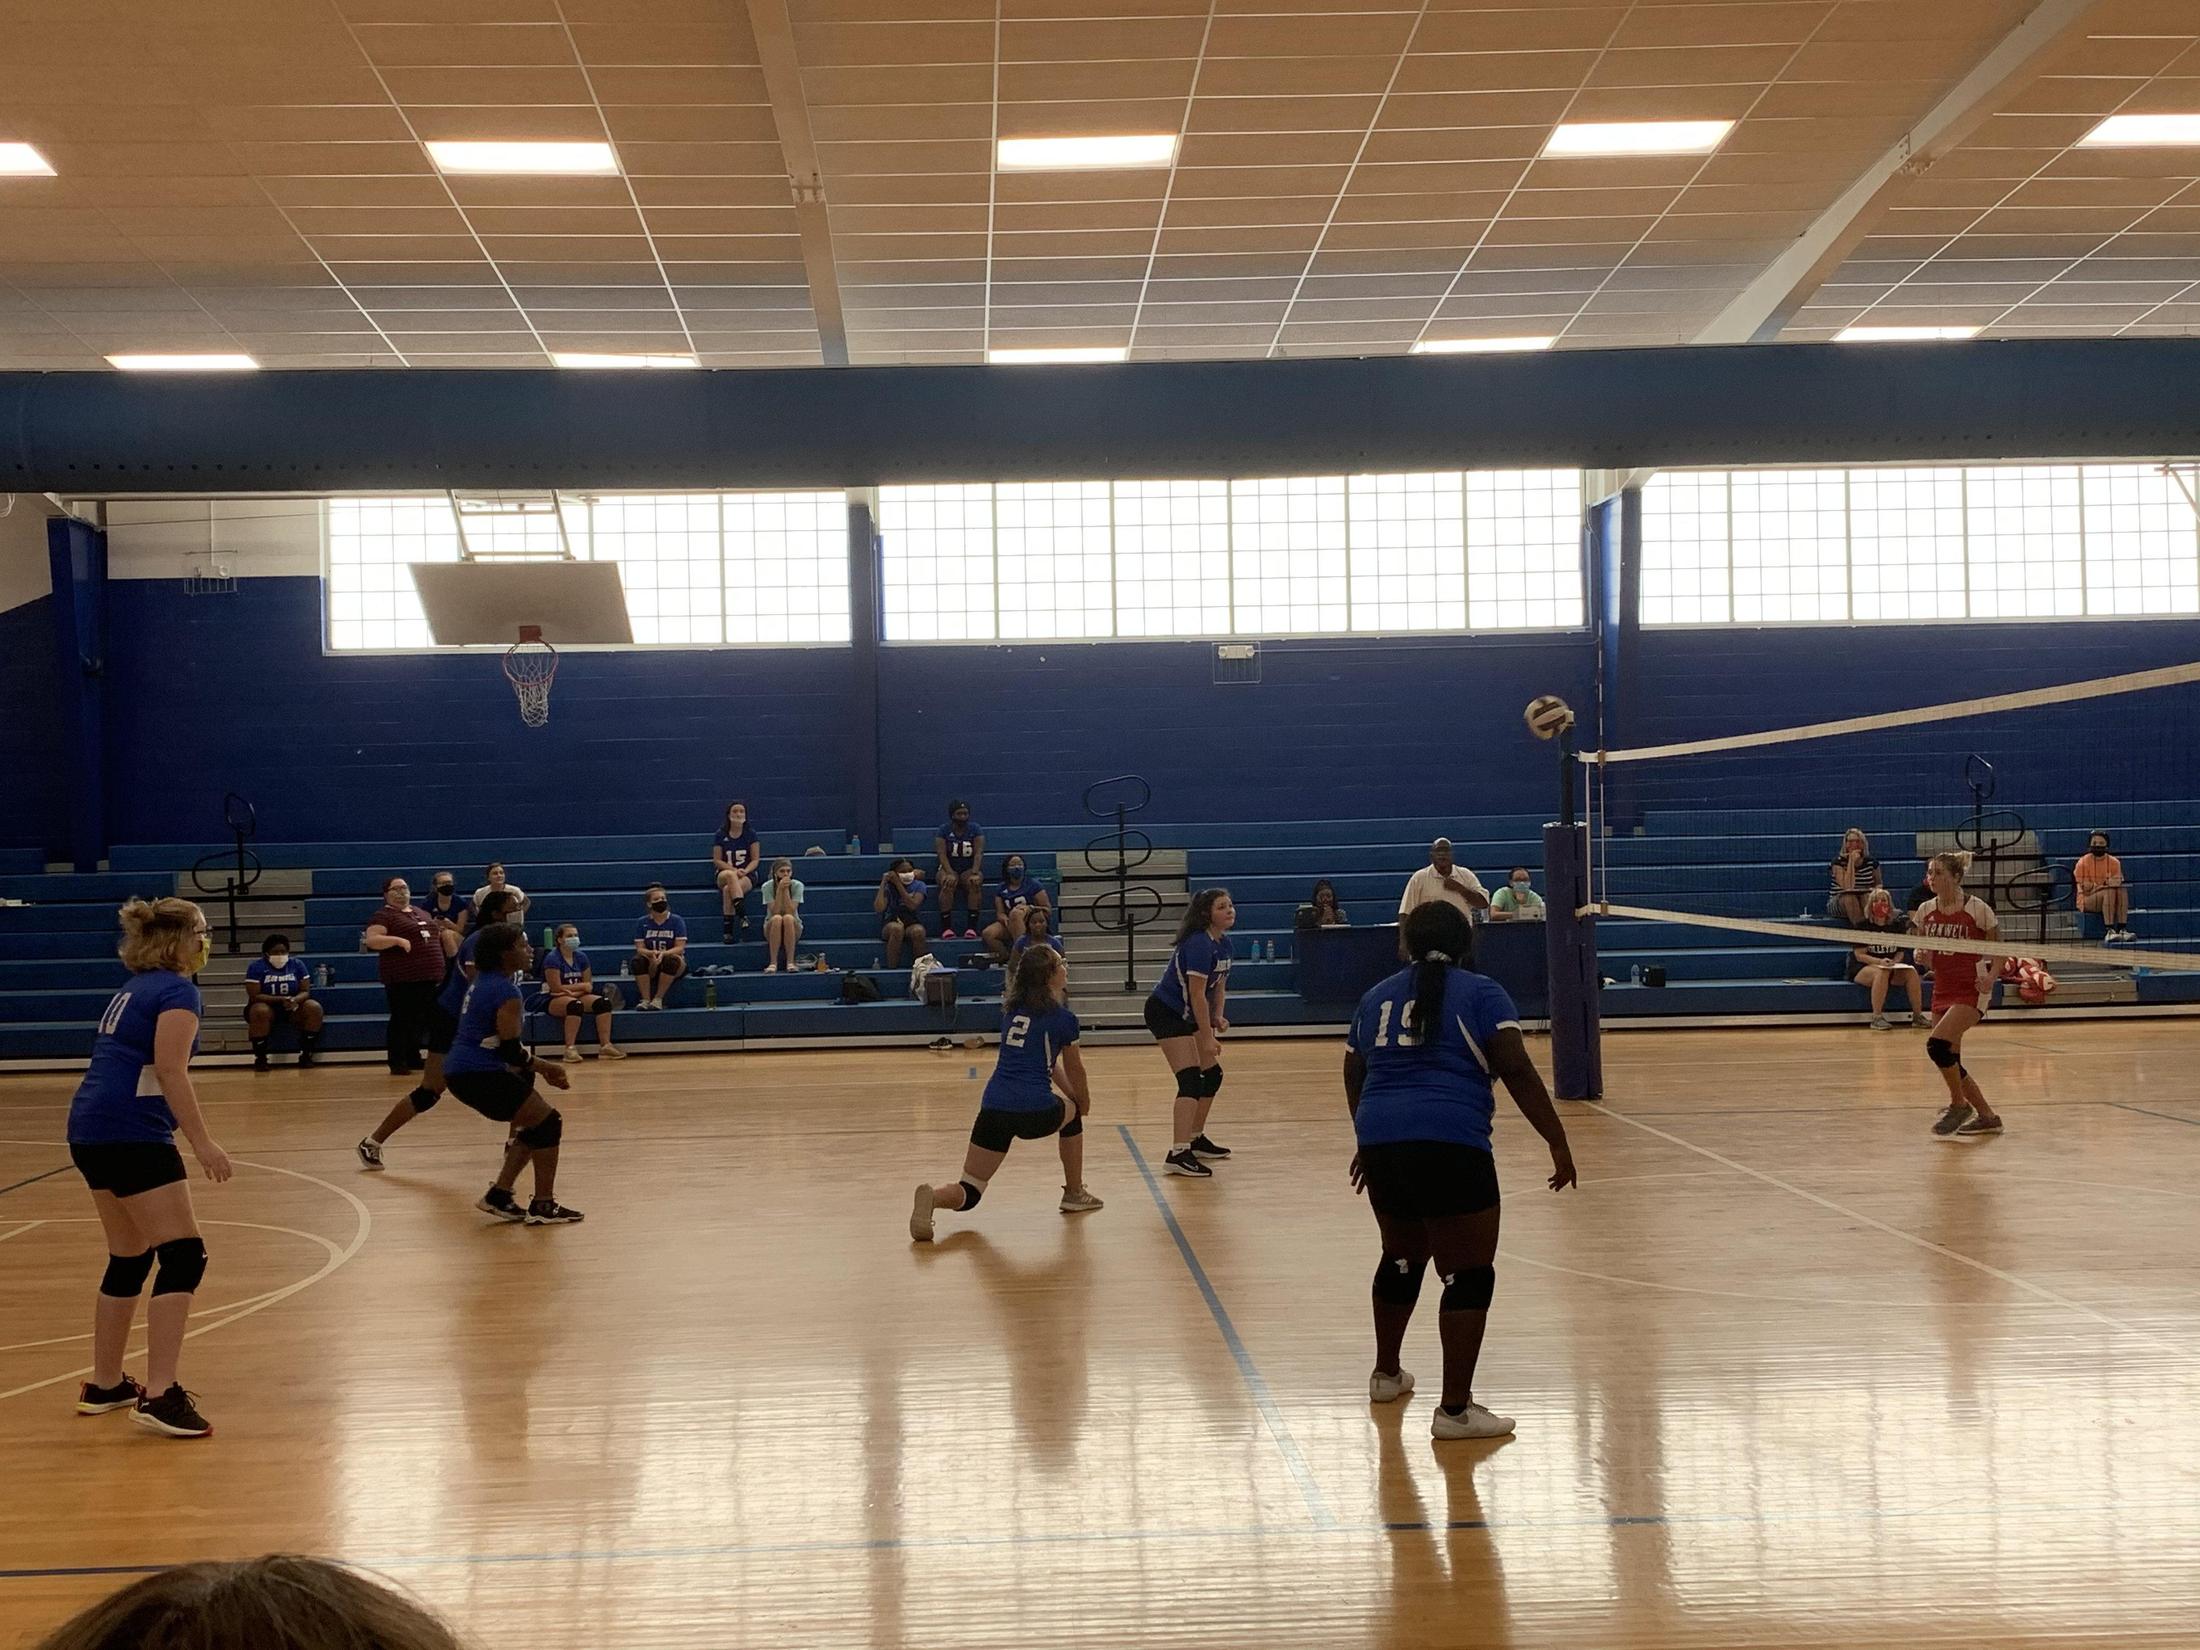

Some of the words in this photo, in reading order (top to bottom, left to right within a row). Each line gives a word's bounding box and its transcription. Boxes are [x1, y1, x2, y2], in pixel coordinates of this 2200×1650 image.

[951, 840, 973, 857] 16
[726, 849, 748, 867] 15
[270, 982, 290, 996] 18
[1005, 1014, 1031, 1048] 2
